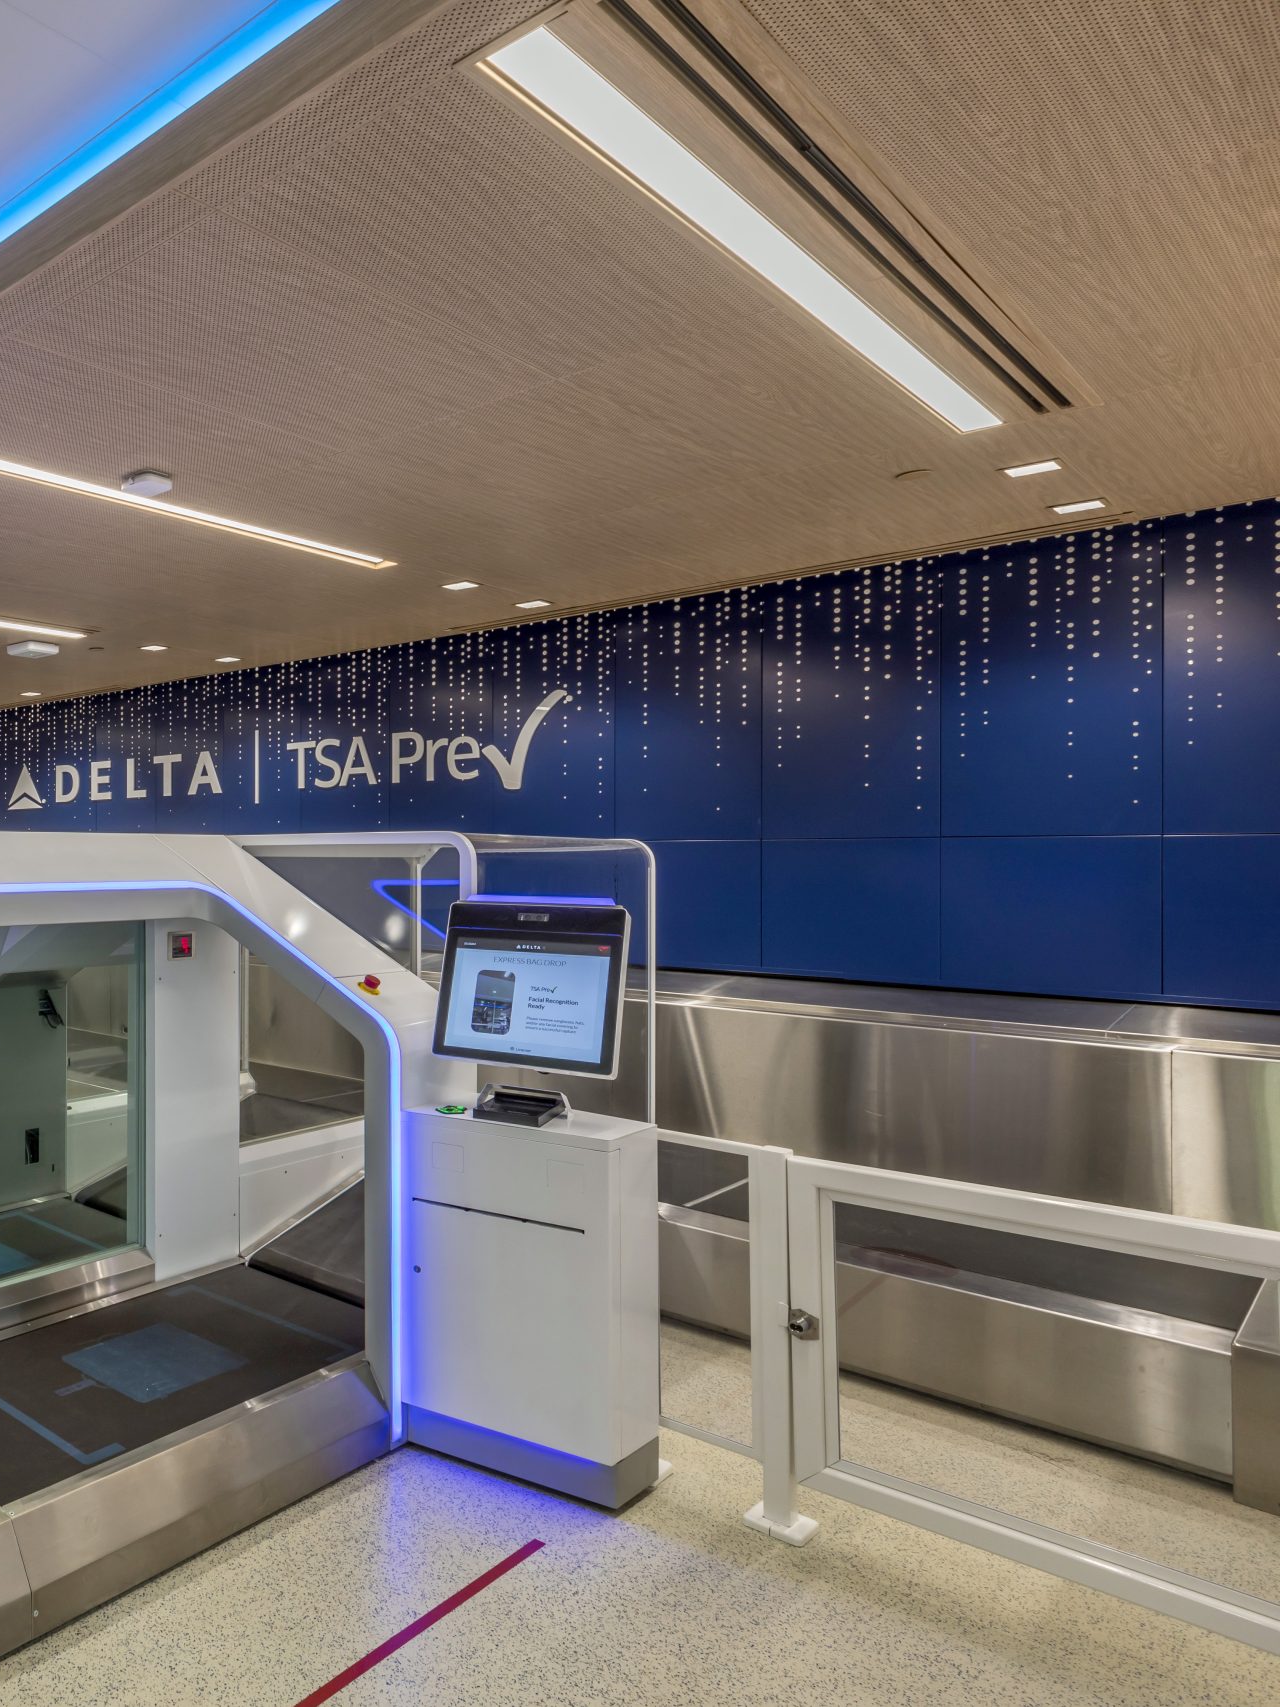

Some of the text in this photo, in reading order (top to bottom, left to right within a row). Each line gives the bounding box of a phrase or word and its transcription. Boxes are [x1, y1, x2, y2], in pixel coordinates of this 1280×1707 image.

[287, 731, 481, 790] TSA Pre
[55, 750, 223, 803] DELTA
[493, 956, 567, 967] EXPRESS BAG DROP
[527, 1003, 545, 1011] Ready
[545, 997, 579, 1006] Recognition
